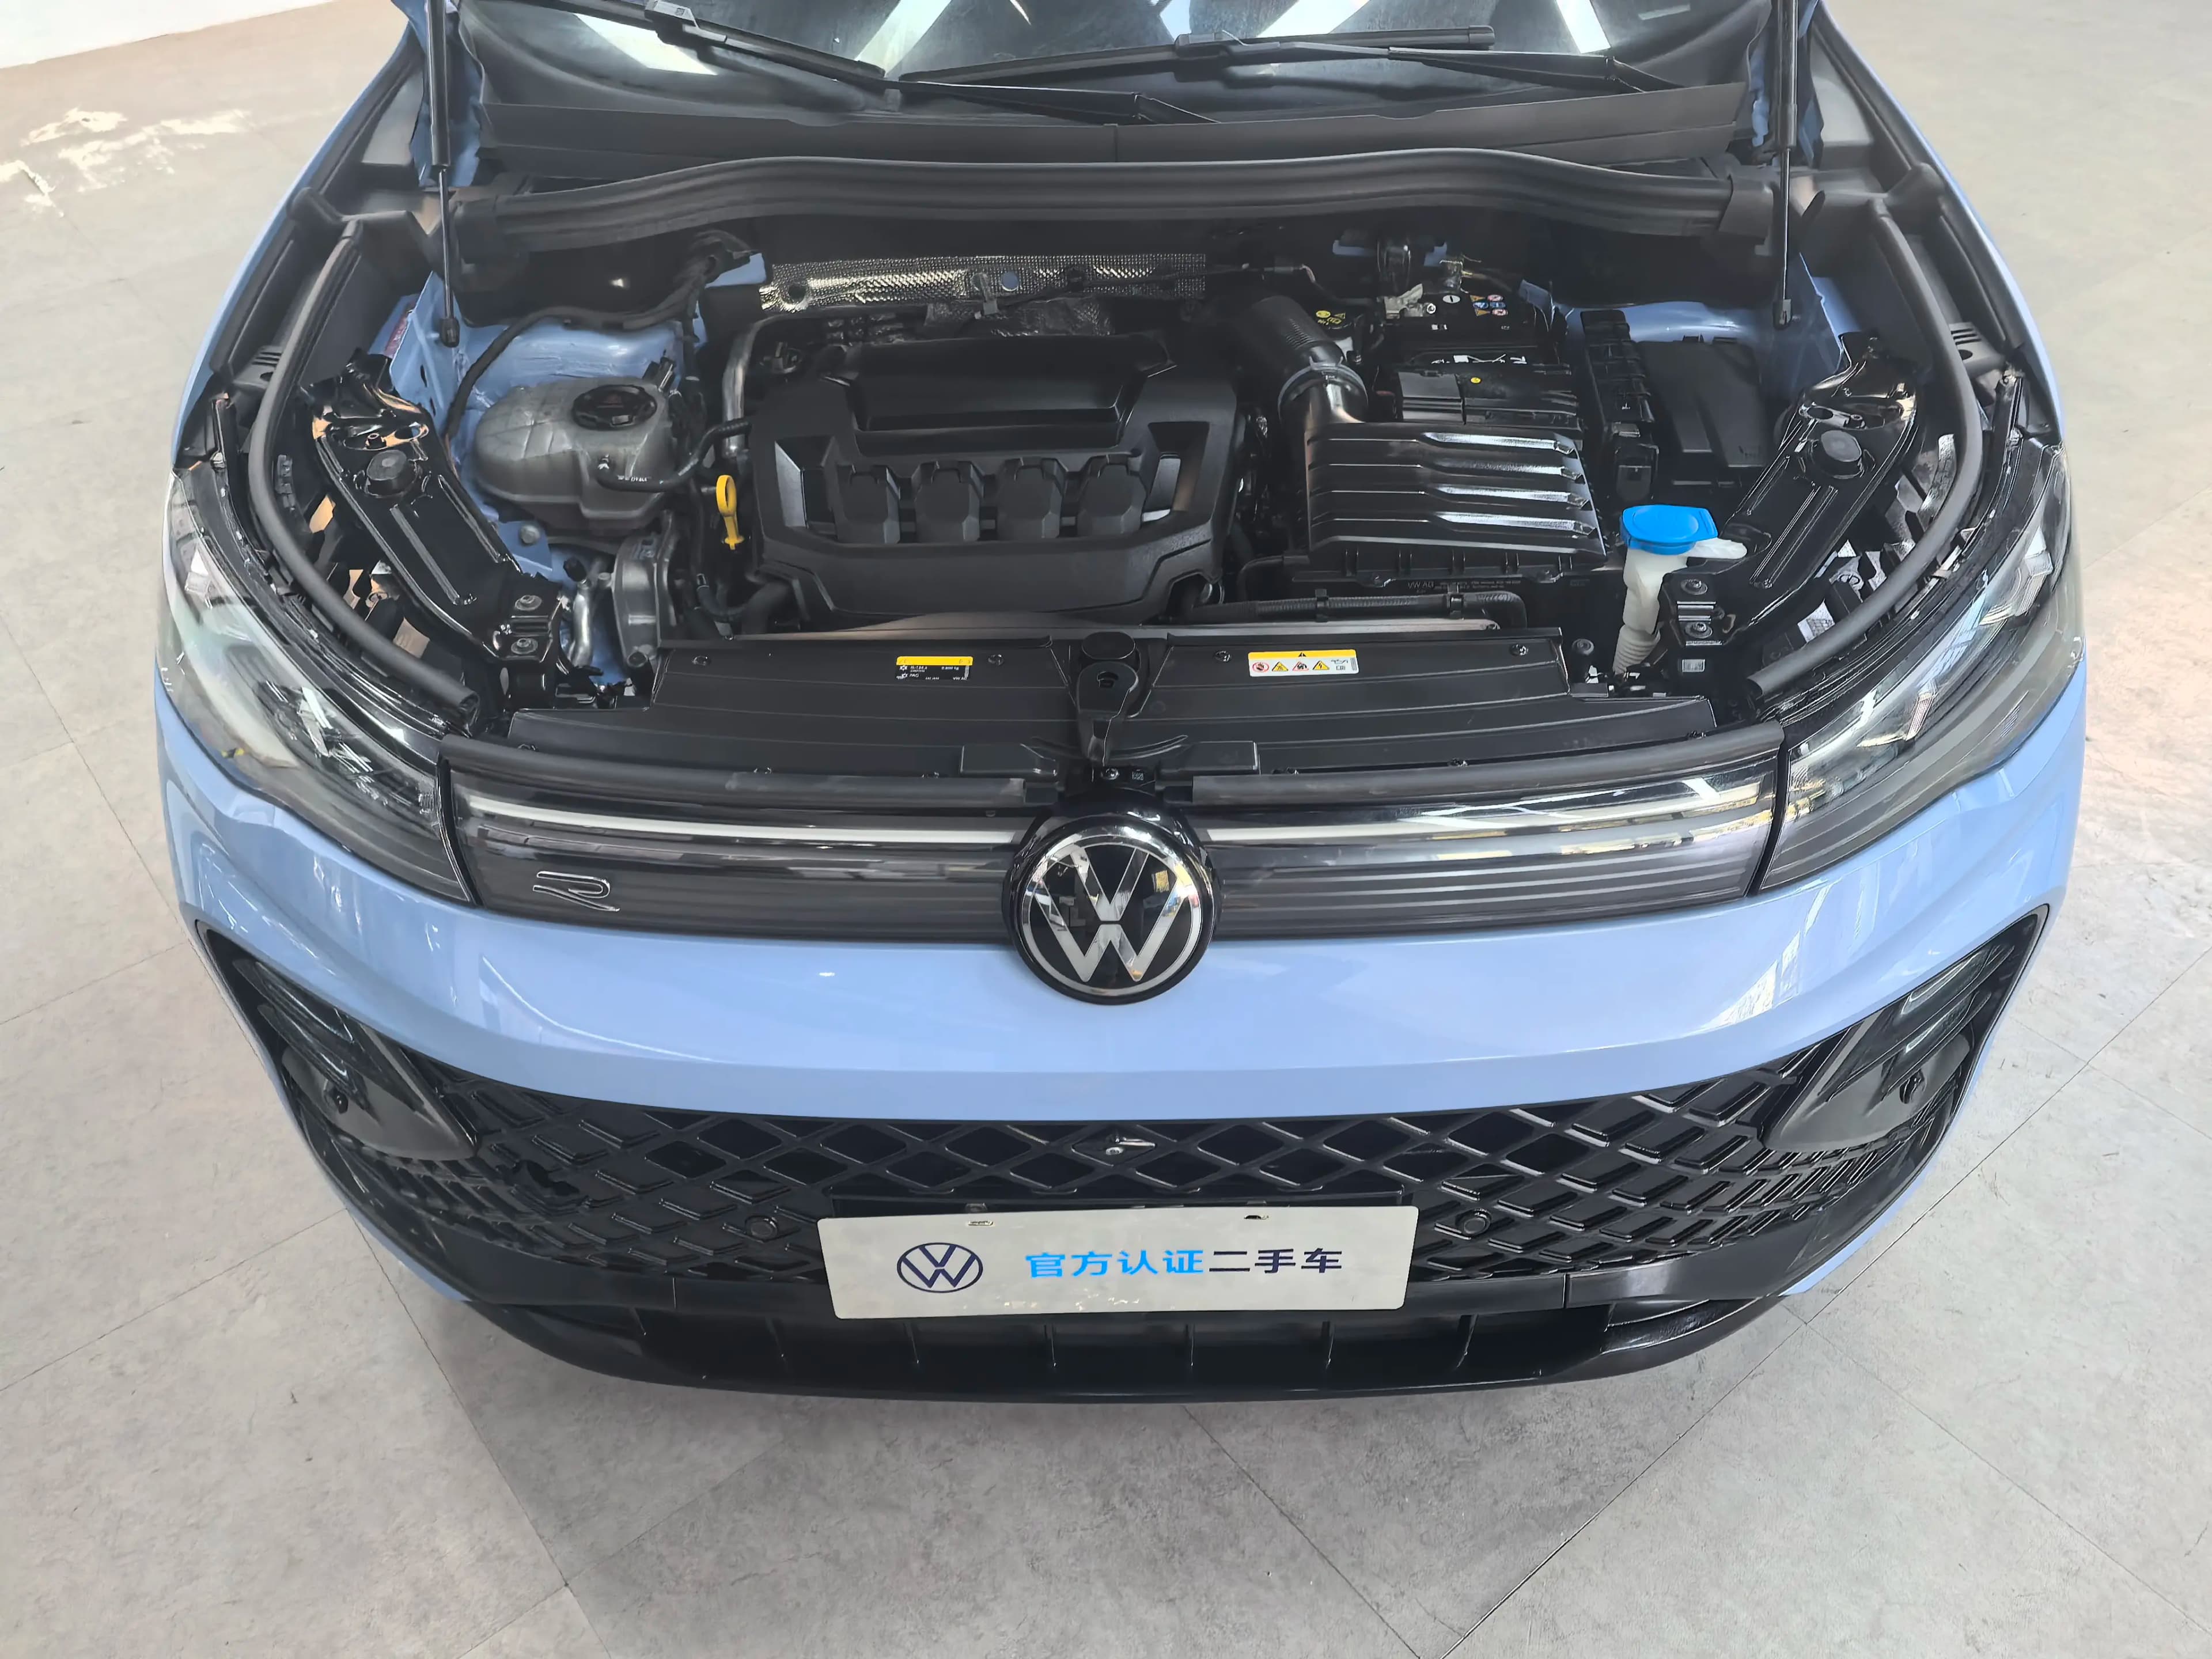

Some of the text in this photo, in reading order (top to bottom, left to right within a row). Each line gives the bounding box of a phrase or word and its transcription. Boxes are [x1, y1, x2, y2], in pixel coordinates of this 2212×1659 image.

[532, 870, 620, 912] R
[1034, 847, 1189, 983] VW
[898, 1243, 982, 1292] VW
[1025, 1248, 1343, 1278] 官方认证二手车
